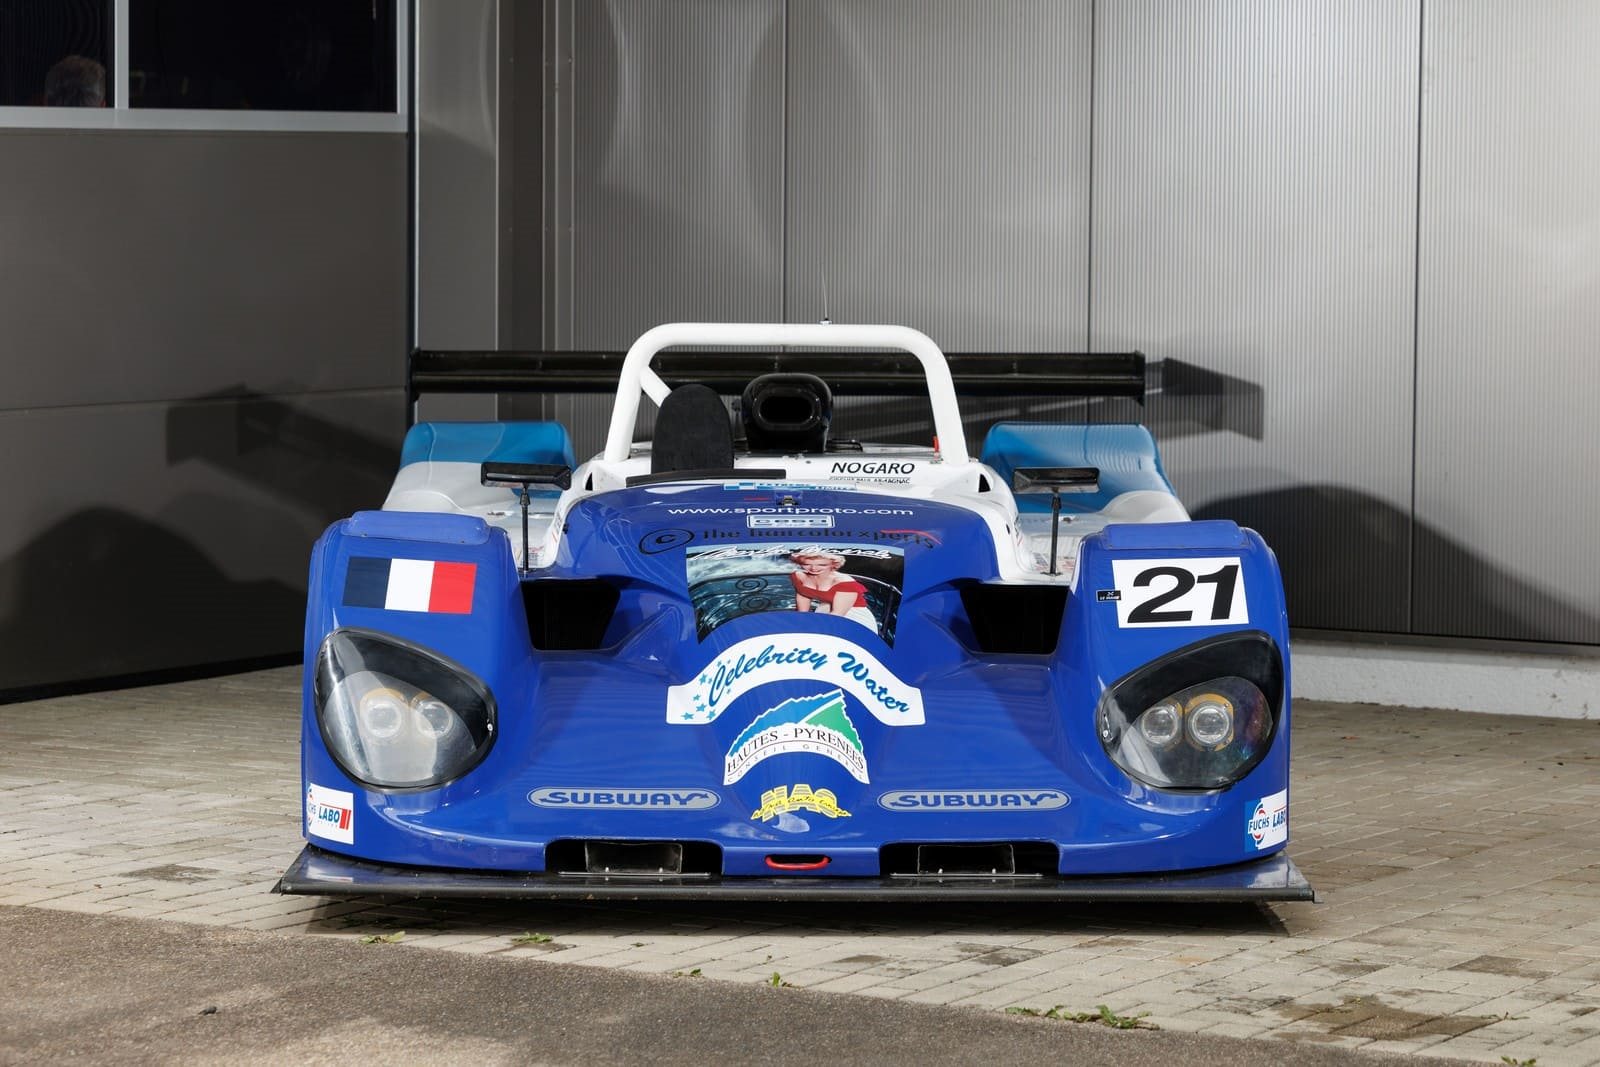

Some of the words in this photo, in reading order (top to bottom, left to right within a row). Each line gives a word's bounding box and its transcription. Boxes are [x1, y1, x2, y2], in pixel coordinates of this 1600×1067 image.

[831, 462, 915, 474] NOGARO
[668, 506, 914, 516] www.sportproto.com
[1127, 564, 1240, 624] 21
[708, 644, 828, 707] Celebrity
[837, 652, 910, 713] Water
[727, 730, 778, 773] HAUTES
[539, 791, 709, 806] SUBWAY
[889, 793, 1060, 808] SUBWAY
[318, 805, 341, 823] LABO
[1249, 817, 1270, 832] FUCHS
